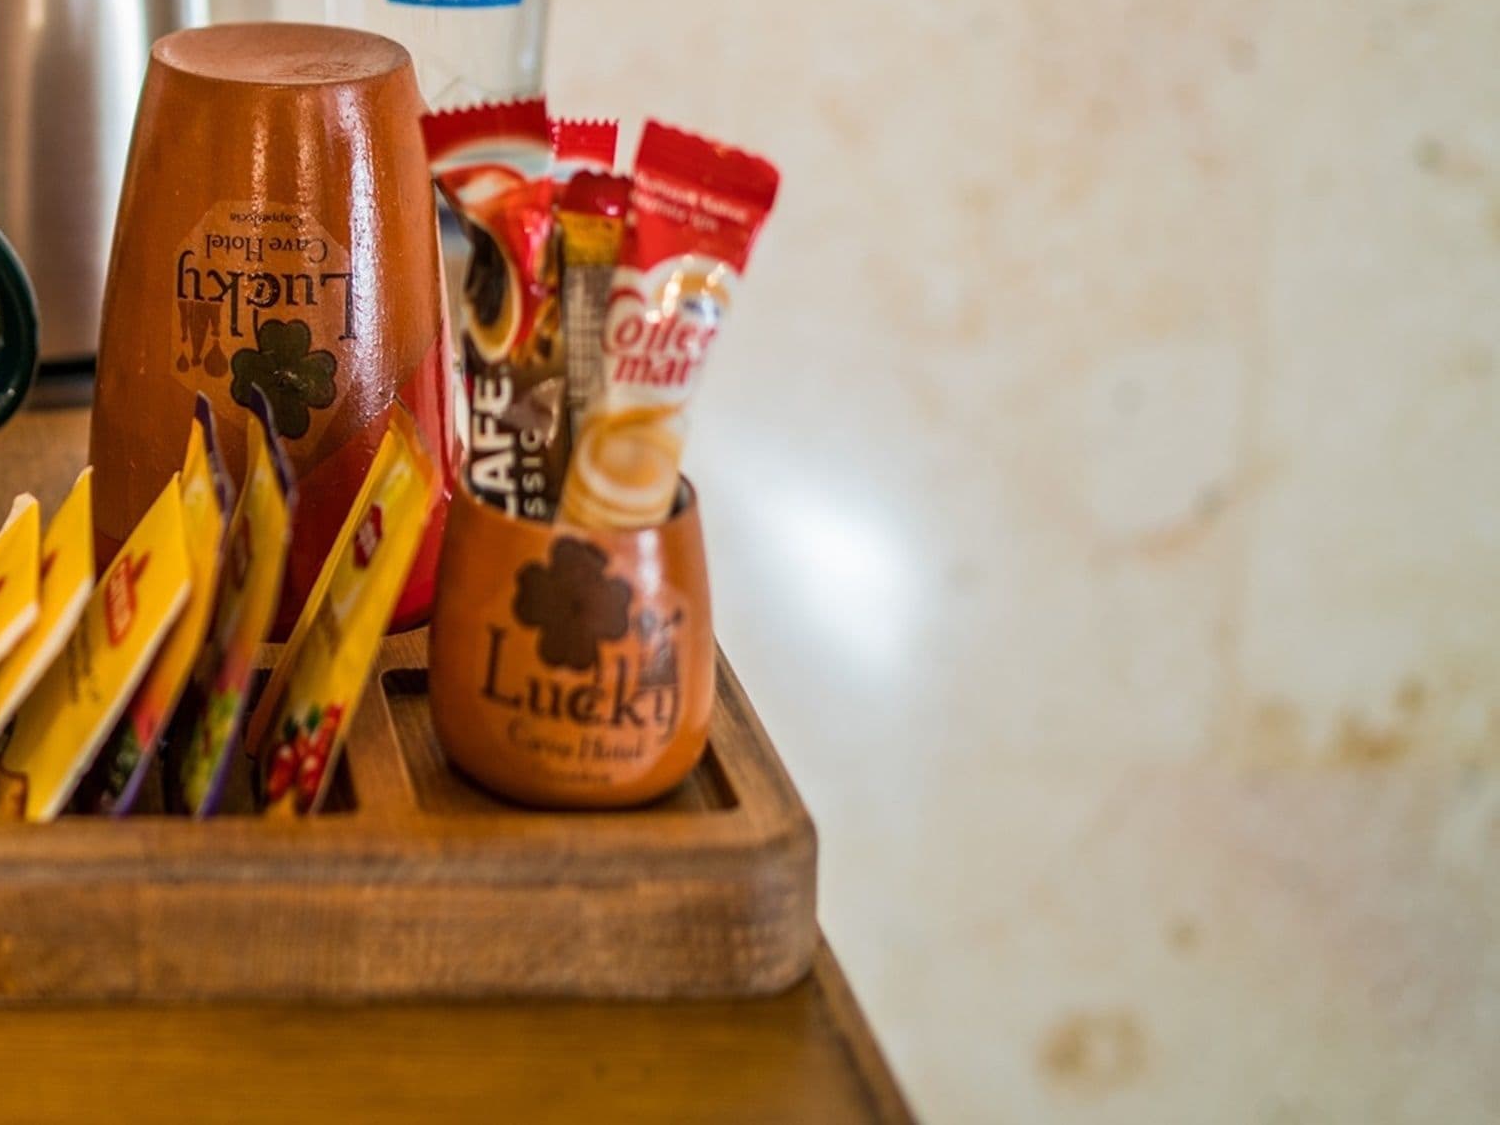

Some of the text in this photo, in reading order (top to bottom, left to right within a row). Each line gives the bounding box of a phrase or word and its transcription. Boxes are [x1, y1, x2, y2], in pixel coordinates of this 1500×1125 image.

[205, 233, 328, 264] Cave Hotel
[177, 250, 357, 341] Lucky
[480, 625, 682, 747] Lucky
